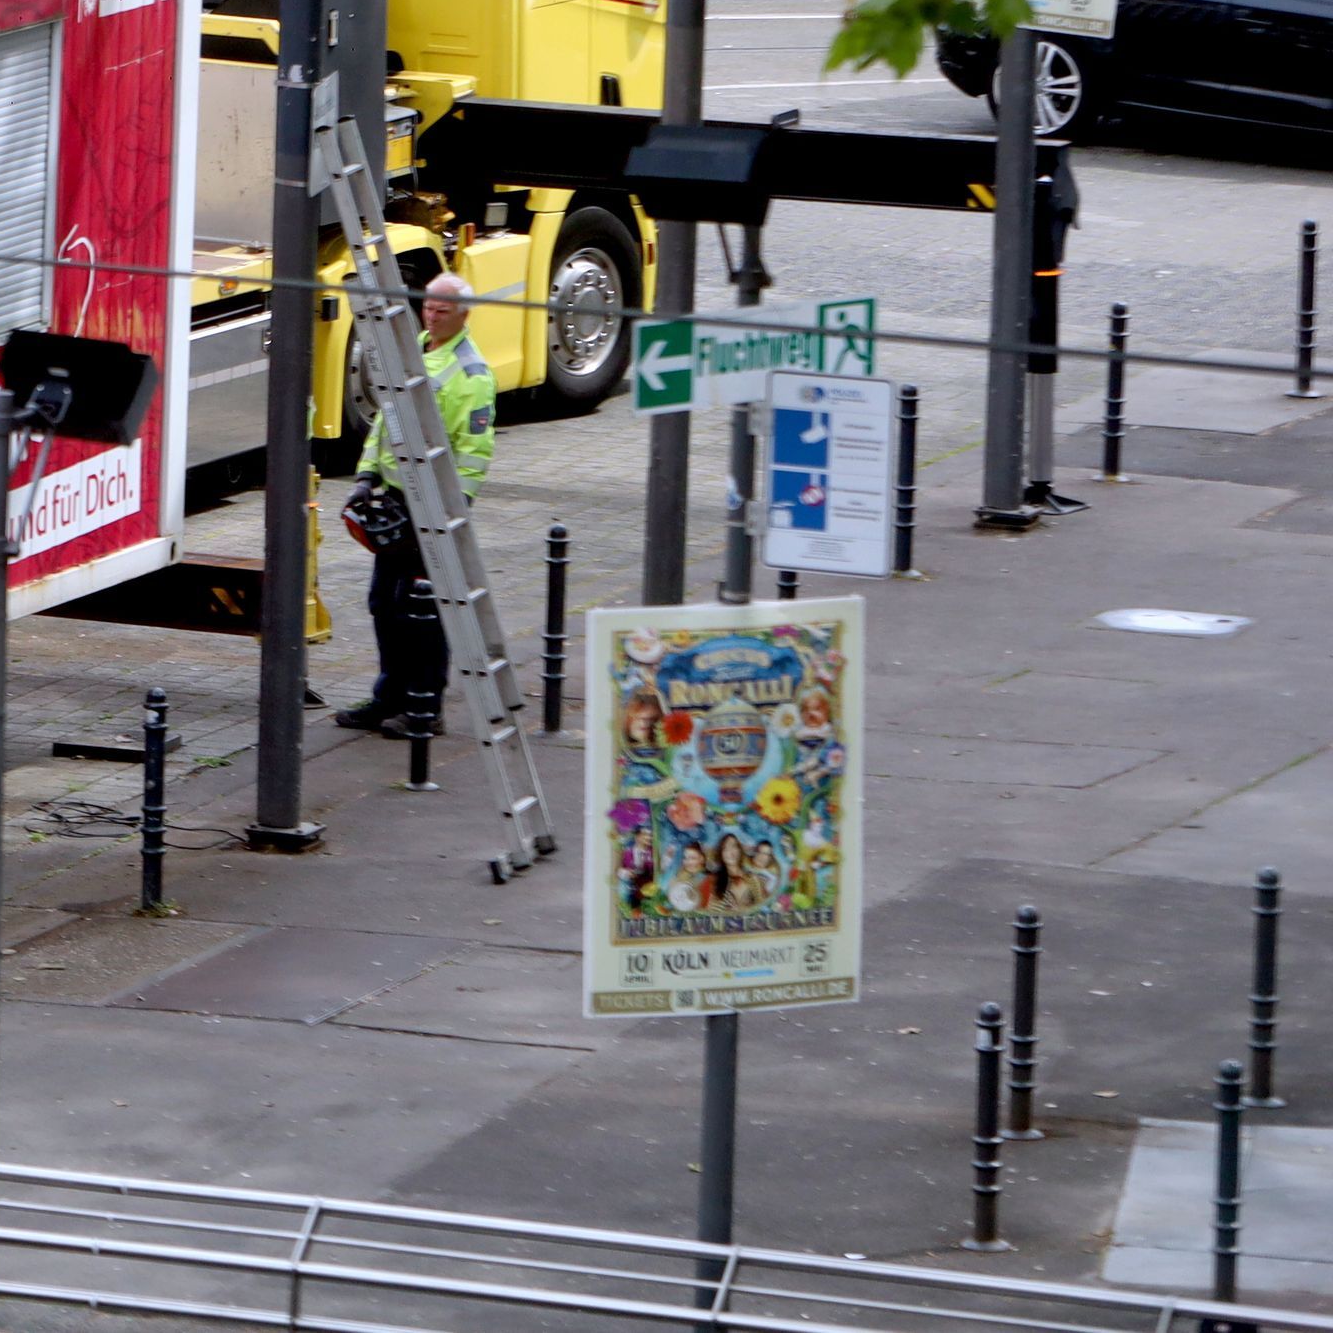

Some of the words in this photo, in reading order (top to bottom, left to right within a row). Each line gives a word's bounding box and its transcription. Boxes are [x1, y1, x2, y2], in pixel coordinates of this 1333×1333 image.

[695, 330, 819, 378] Fluchtweg
[51, 479, 80, 528] für
[85, 466, 135, 519] Dich.
[668, 676, 794, 706] RONCALLI
[626, 954, 649, 973] 10
[661, 949, 710, 975] KÖLN
[719, 945, 797, 968] NEUMARKT
[803, 943, 828, 963] 25
[600, 993, 665, 1009] TICKETS
[703, 981, 850, 1006] WWW.RONCALLI.DE
